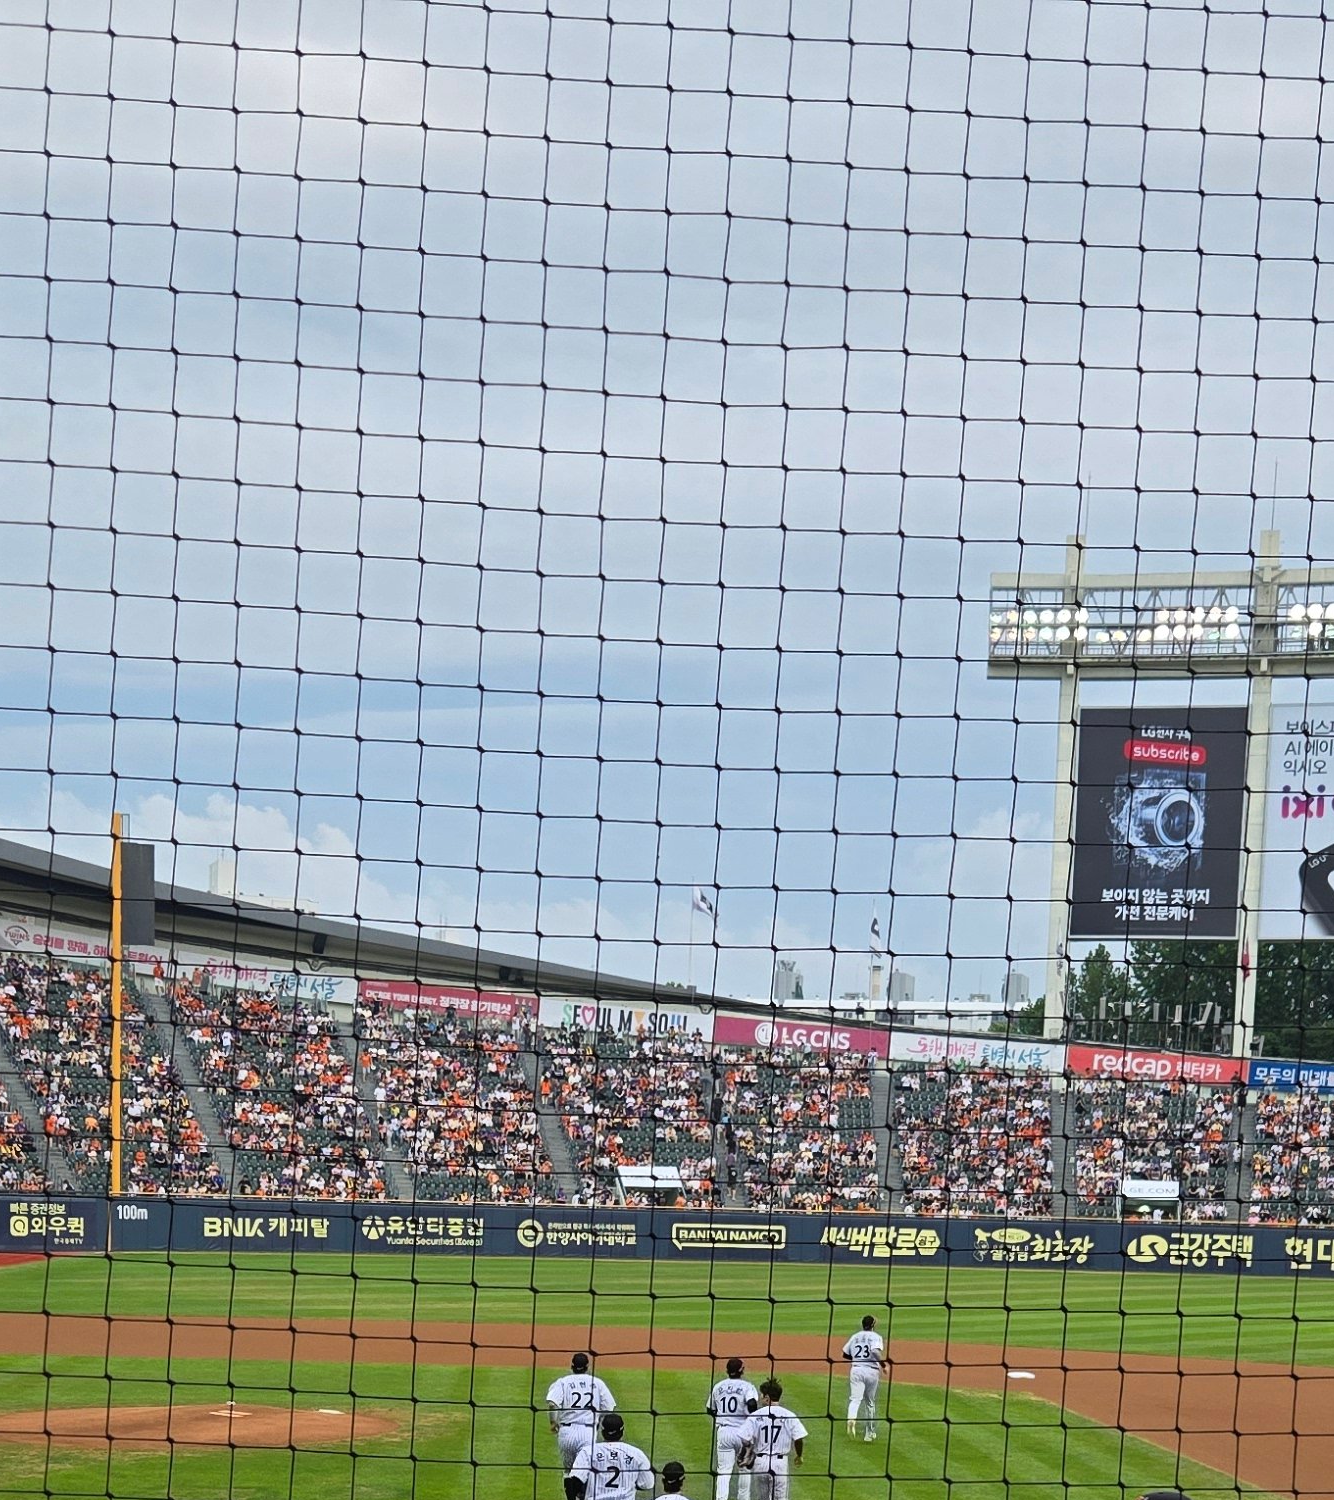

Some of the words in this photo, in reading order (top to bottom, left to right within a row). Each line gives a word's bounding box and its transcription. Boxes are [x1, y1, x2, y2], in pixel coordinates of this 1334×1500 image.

[1133, 745, 1200, 761] subscribe
[1284, 741, 1301, 755] AI
[1283, 759, 1327, 776] 익시오
[1101, 888, 1139, 904] 보이지
[1142, 888, 1168, 904] 않는
[1171, 888, 1210, 904] 곳까지
[1114, 905, 1140, 921] 가전
[1143, 905, 1195, 921] 전문케어
[781, 1028, 808, 1047] LG
[810, 1030, 851, 1050] CNS
[1093, 1051, 1171, 1078] redcap
[1176, 1061, 1222, 1080] 렌터카
[1253, 1067, 1296, 1084] 모두의
[9, 1202, 29, 1214] 빠른
[30, 1202, 66, 1215] 증권정보
[117, 1204, 148, 1221] 100m
[30, 1216, 84, 1237] 와우퀵
[203, 1217, 266, 1238] BNK
[268, 1216, 330, 1238] 캐피탈
[679, 1228, 728, 1241] BANDAI
[730, 1229, 780, 1243] NAMCO
[1169, 1231, 1255, 1267] 금강주택
[854, 1345, 870, 1358] 23
[571, 1391, 595, 1409] 22
[720, 1396, 738, 1414] 10
[761, 1425, 782, 1444] 17
[605, 1465, 620, 1489] 2
